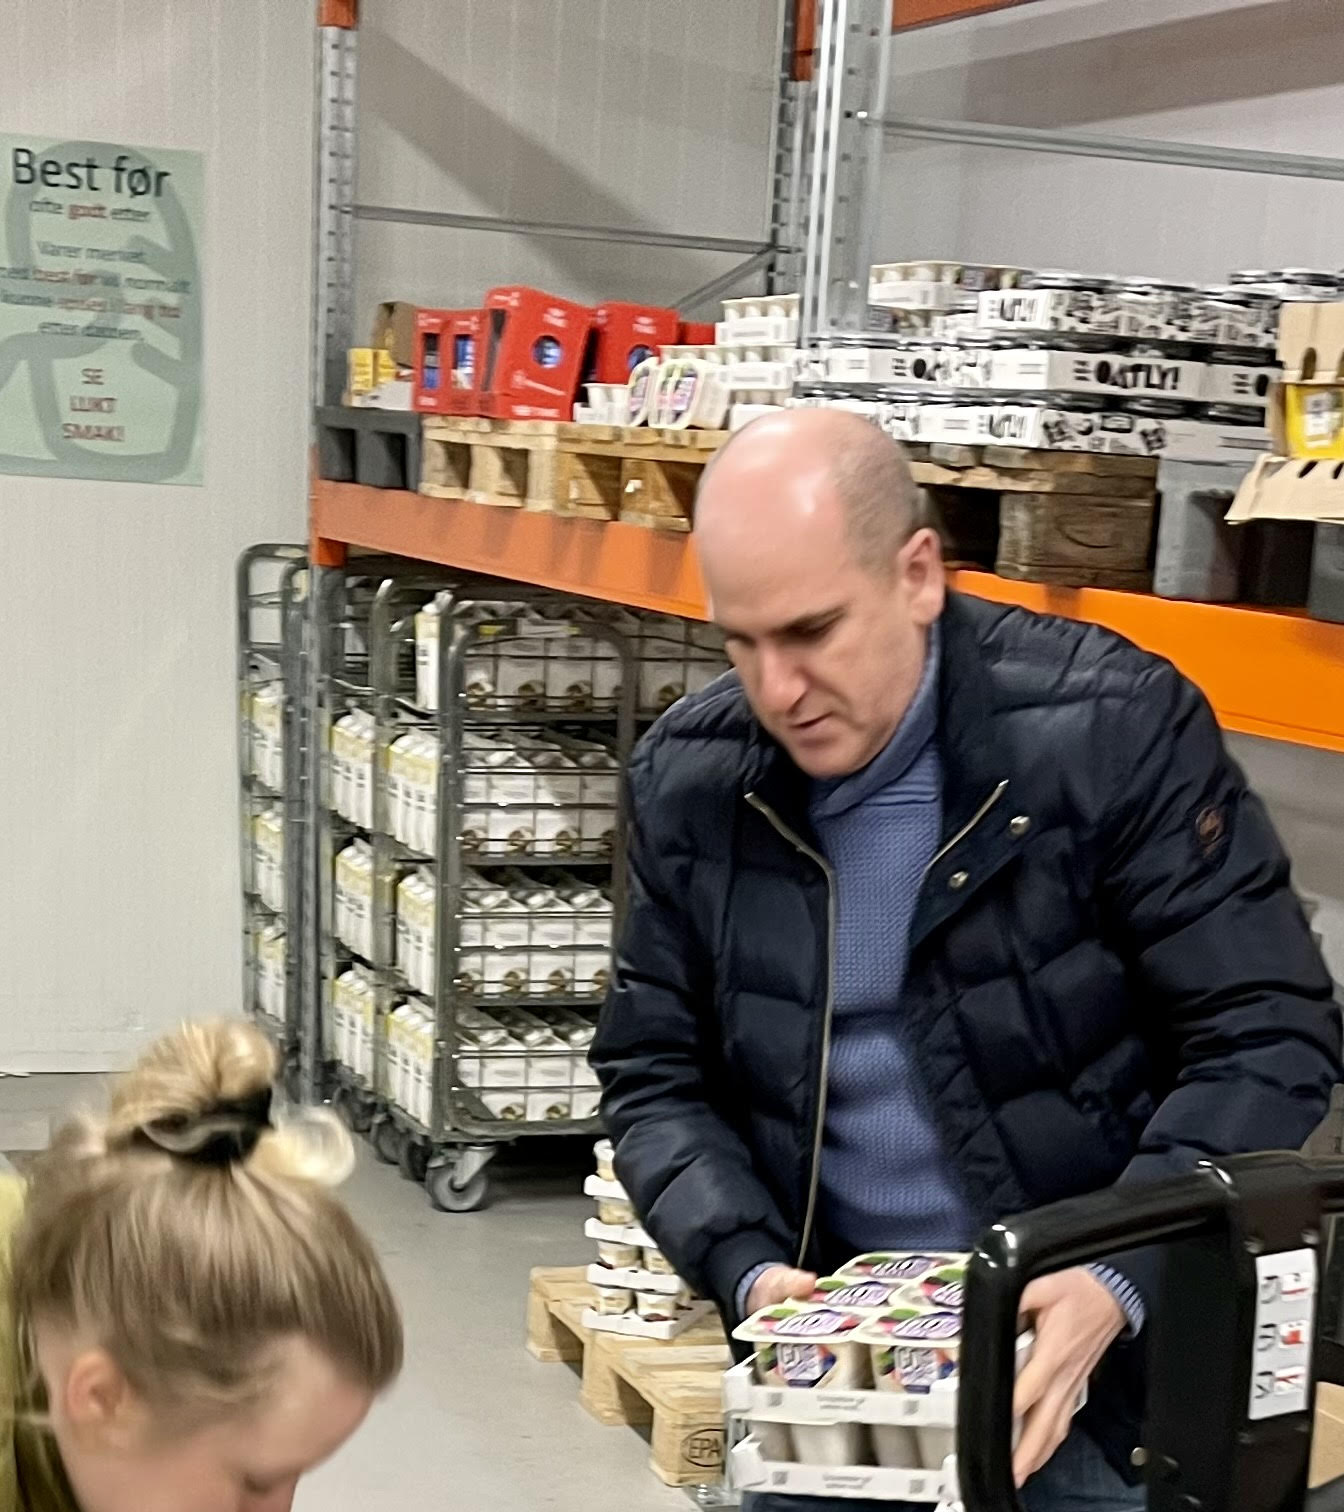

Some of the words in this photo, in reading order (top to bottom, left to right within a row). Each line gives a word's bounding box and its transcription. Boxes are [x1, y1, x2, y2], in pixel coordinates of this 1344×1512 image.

[12, 146, 101, 191] Best
[112, 155, 171, 198] før
[80, 367, 105, 386] SE
[688, 1437, 723, 1459] EPA
